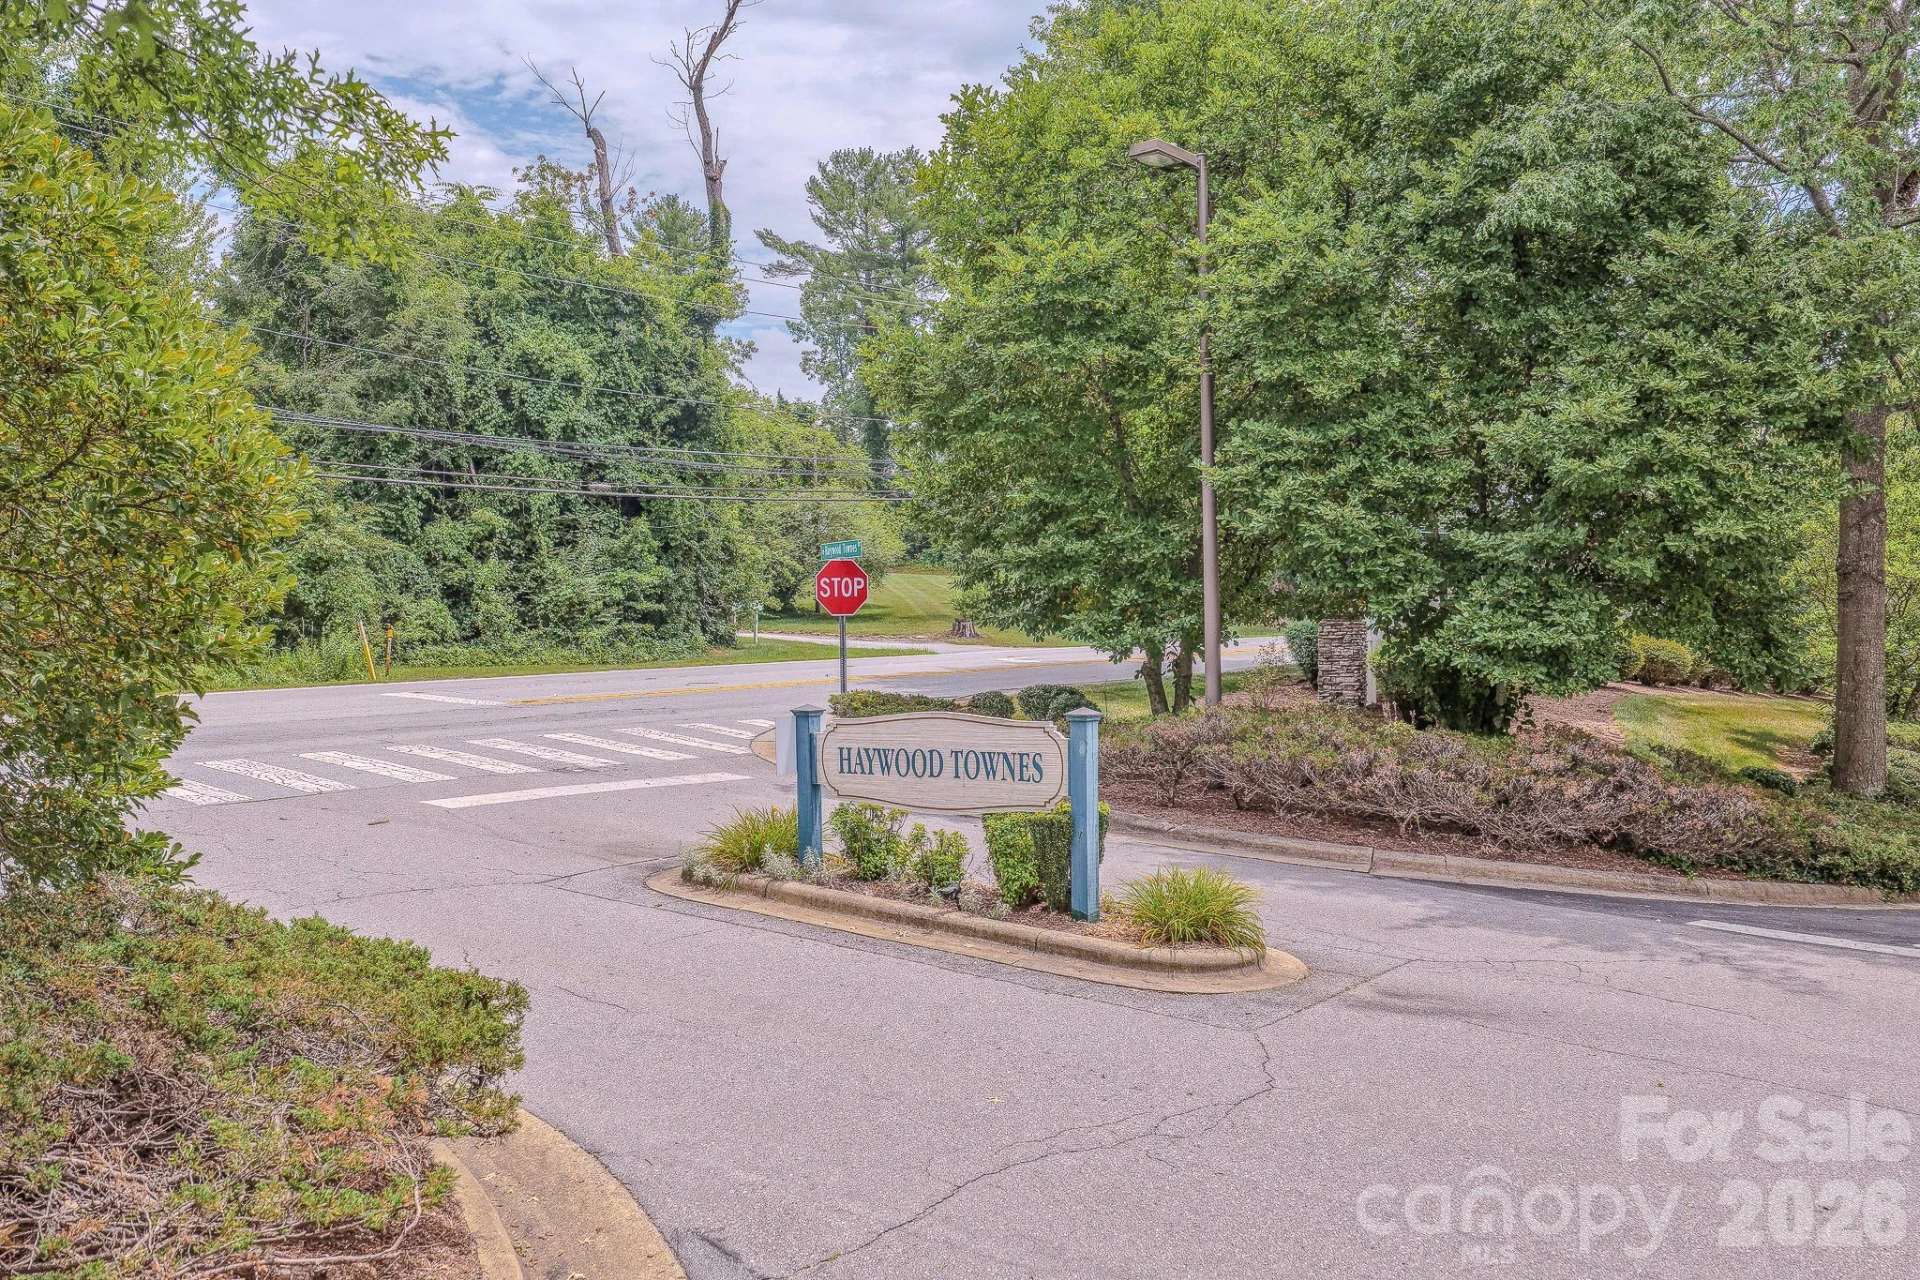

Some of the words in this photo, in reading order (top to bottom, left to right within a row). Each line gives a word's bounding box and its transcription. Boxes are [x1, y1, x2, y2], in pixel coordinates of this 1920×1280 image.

[820, 577, 865, 598] STOP
[838, 746, 944, 778] HAYWOOD
[951, 749, 1044, 784] TOWNES
